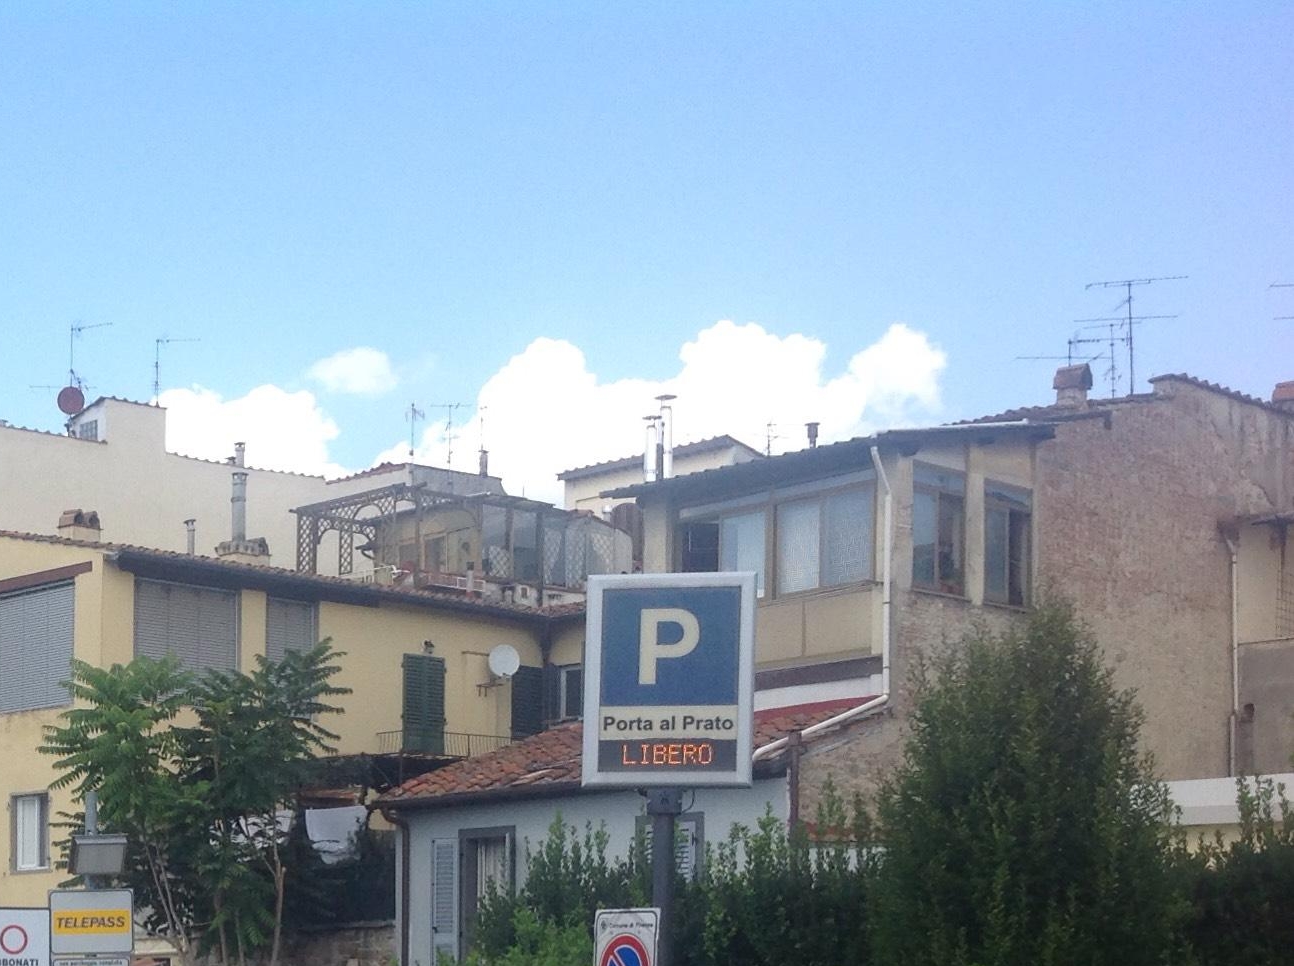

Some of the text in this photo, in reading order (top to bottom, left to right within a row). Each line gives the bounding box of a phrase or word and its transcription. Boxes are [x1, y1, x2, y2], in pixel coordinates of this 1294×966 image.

[638, 608, 700, 685] P
[603, 715, 734, 732] Porta al Prato
[622, 744, 712, 765] LIBERO
[57, 916, 125, 928] TELEPASS
